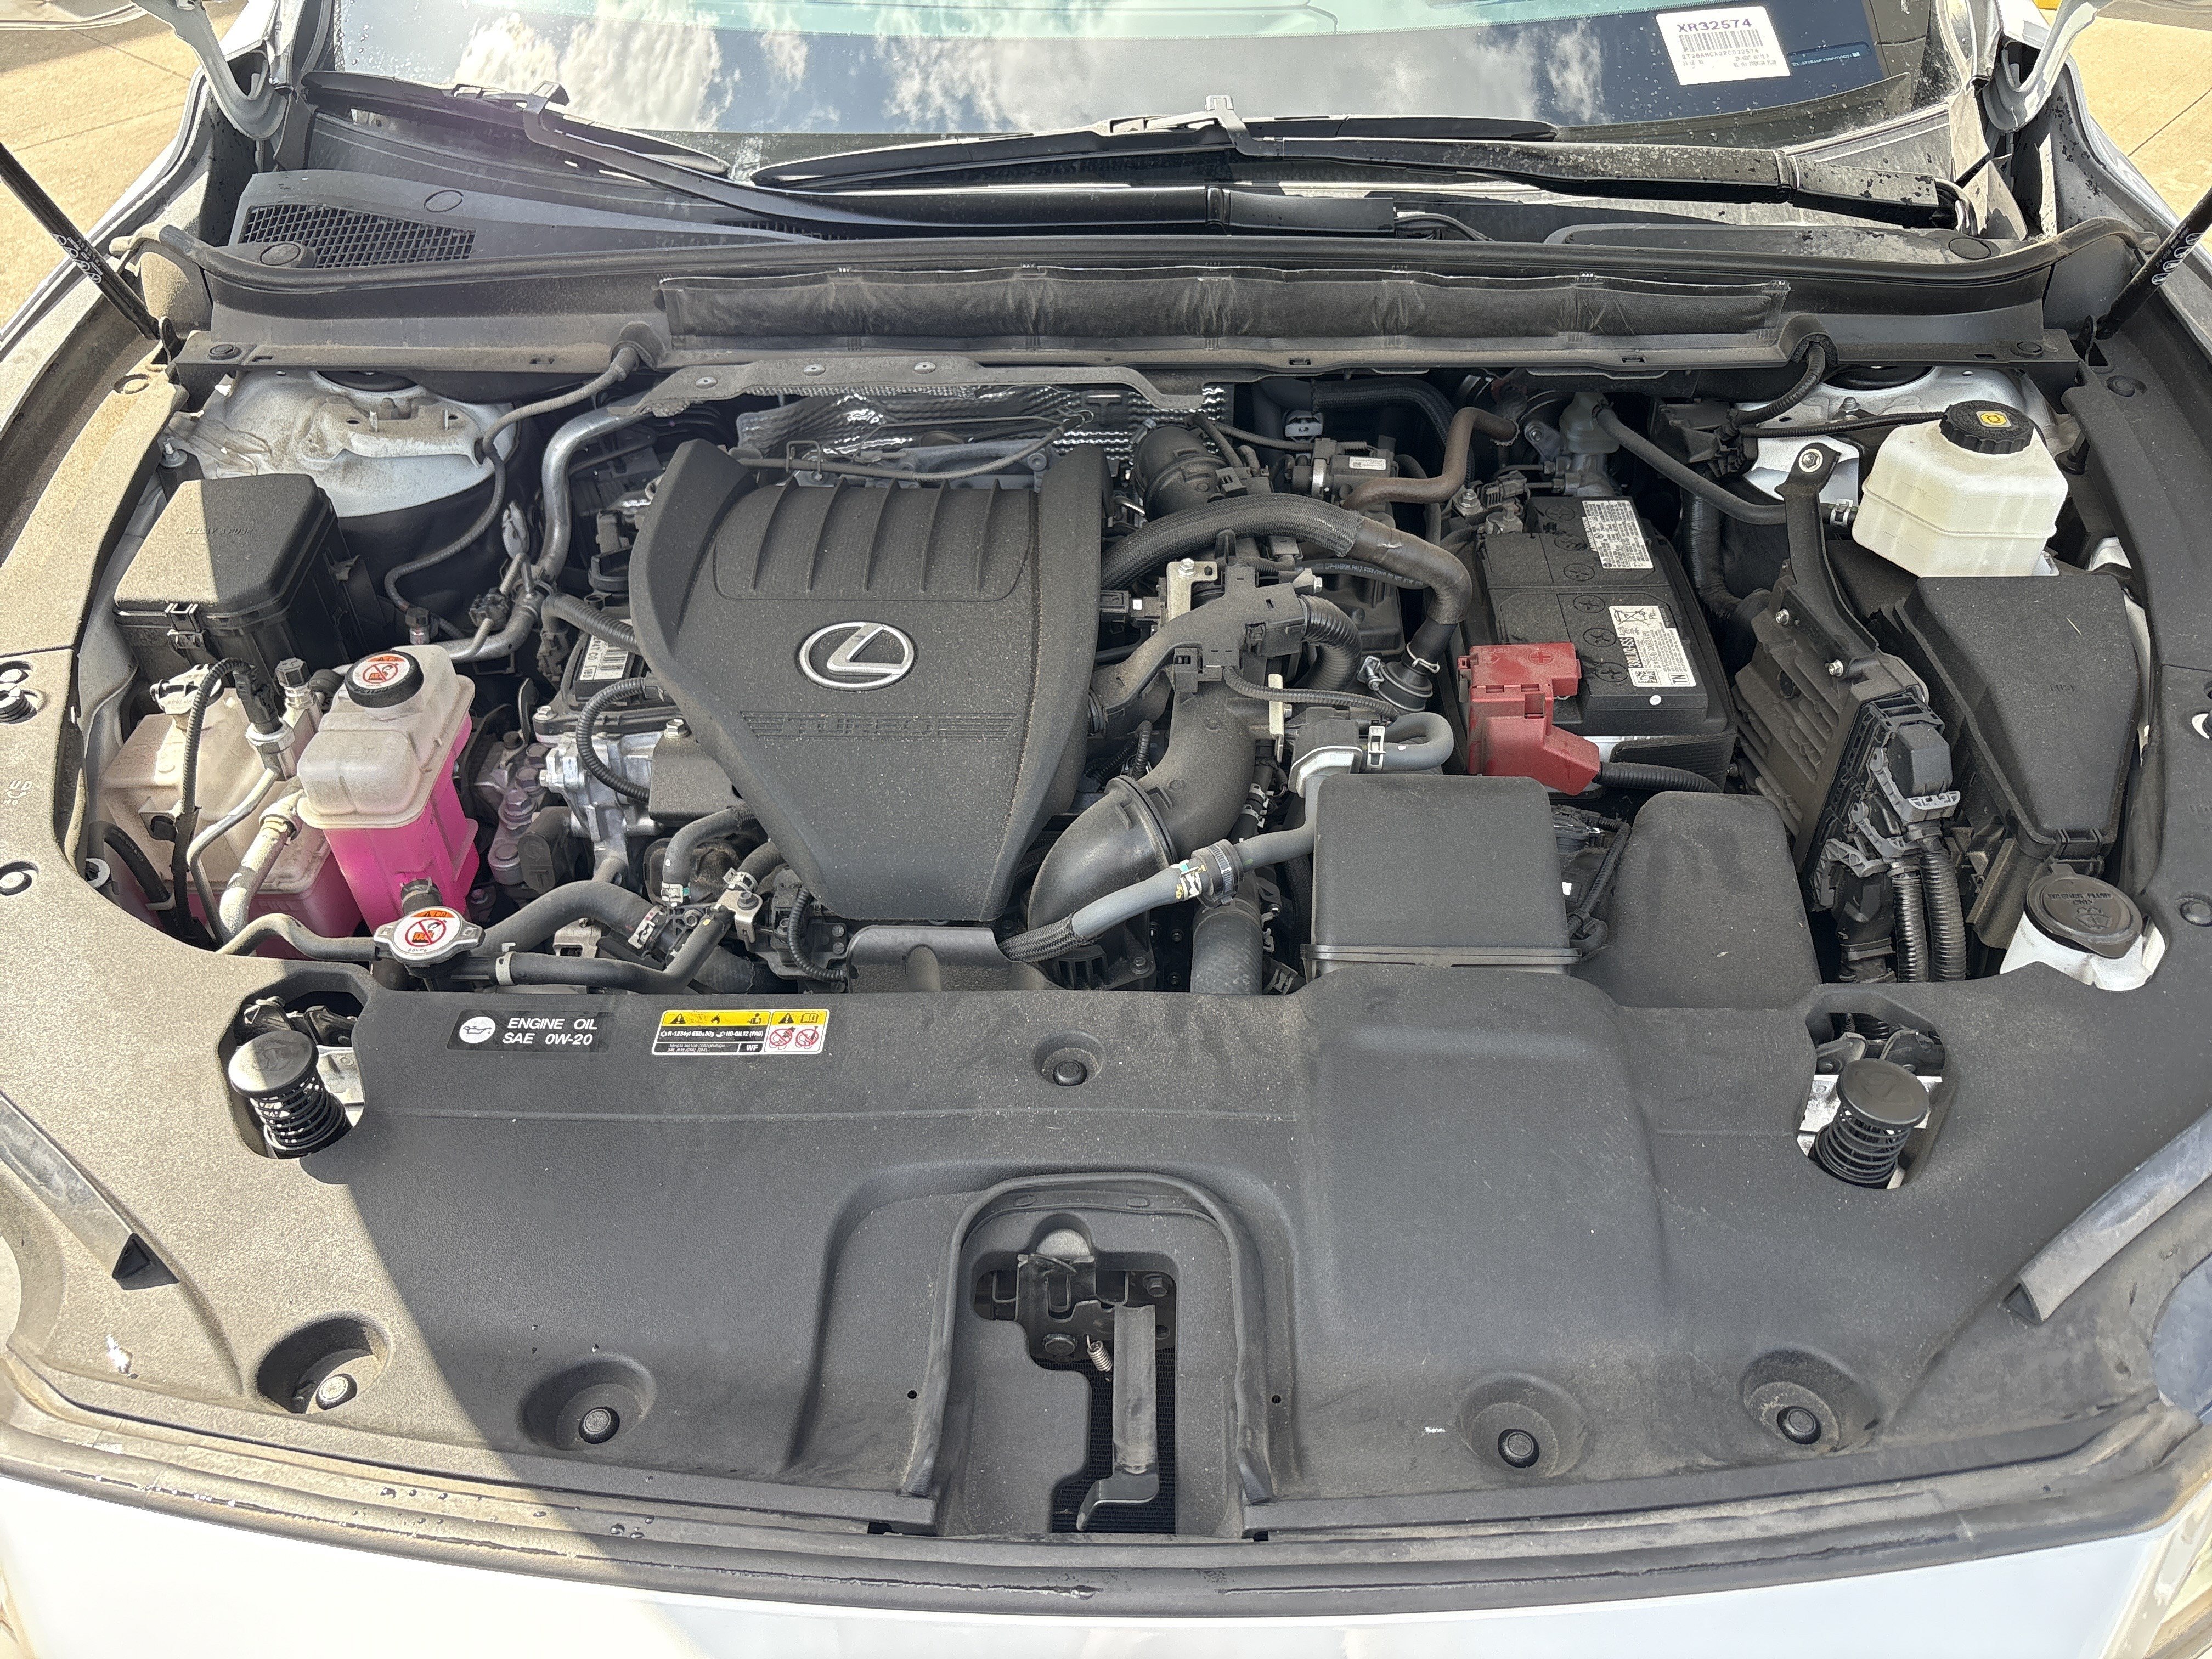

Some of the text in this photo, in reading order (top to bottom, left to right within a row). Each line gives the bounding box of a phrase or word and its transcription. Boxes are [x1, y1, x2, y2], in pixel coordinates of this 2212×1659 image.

[1677, 19, 1752, 33] XR32574
[507, 1017, 598, 1030] ENGINE OIL
[502, 1032, 594, 1045] SAE 0W-20
